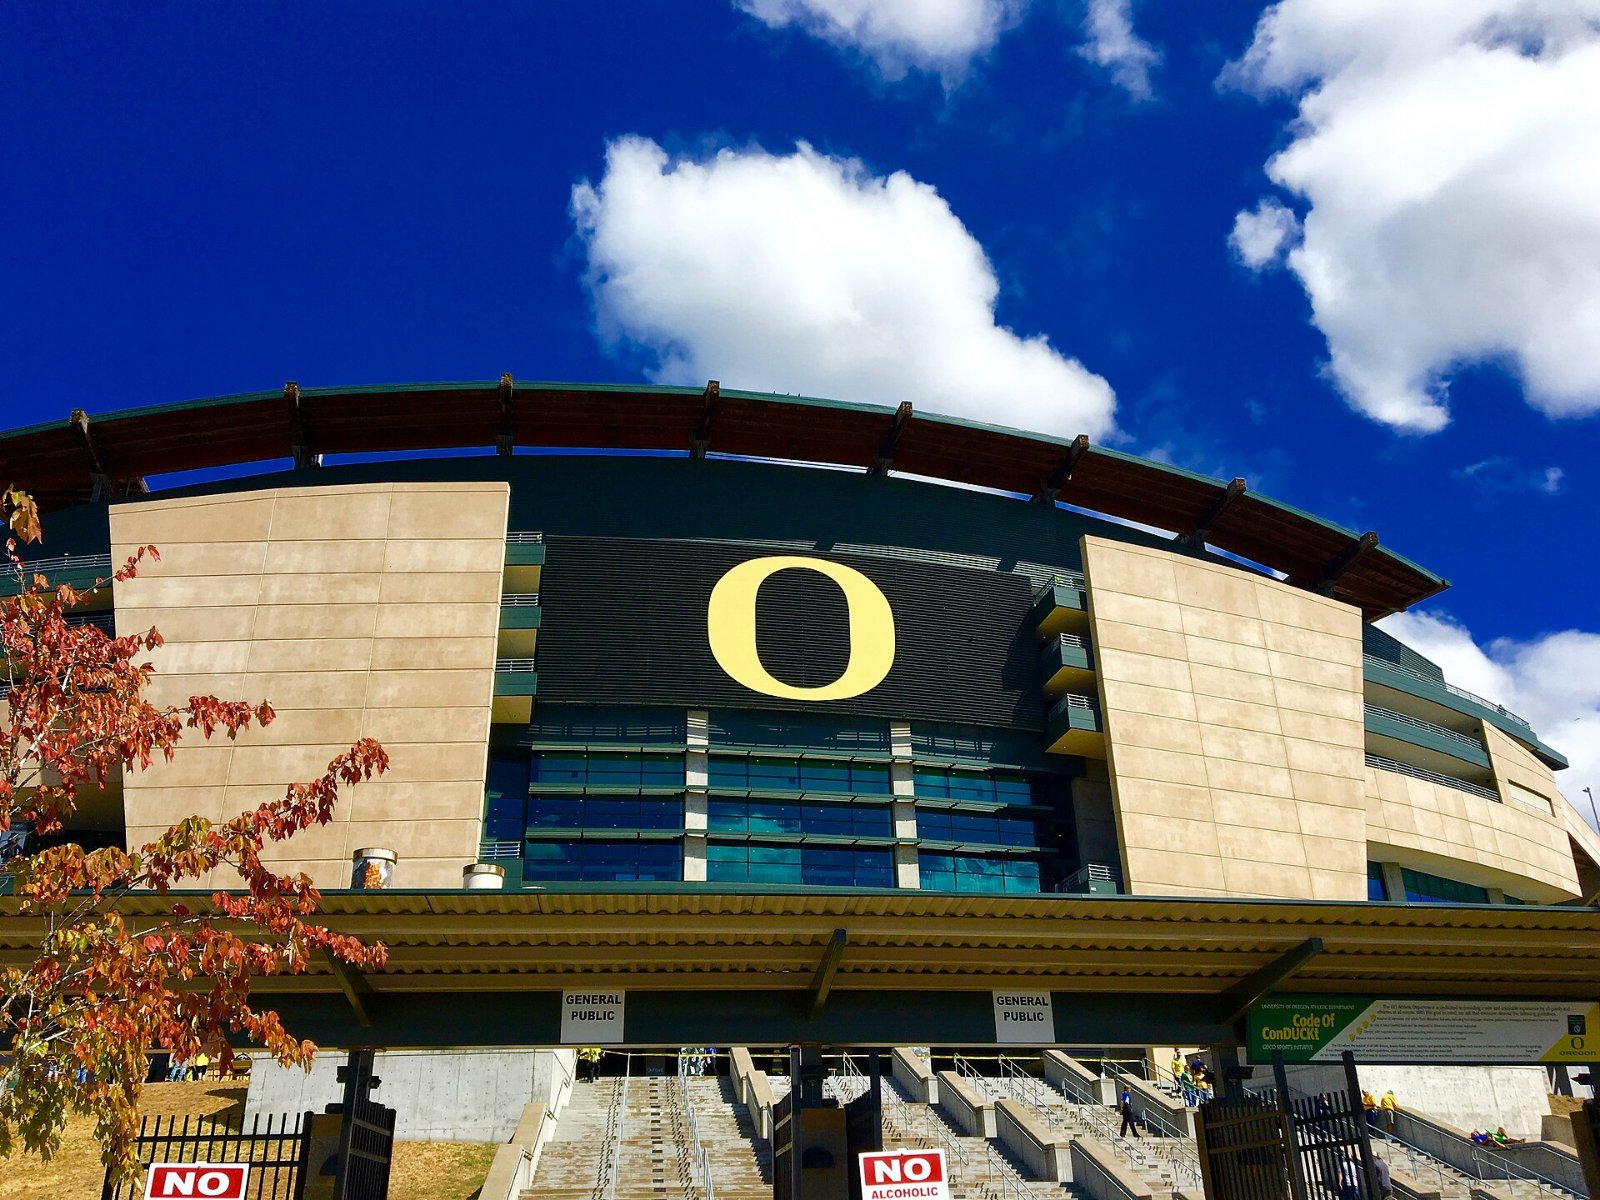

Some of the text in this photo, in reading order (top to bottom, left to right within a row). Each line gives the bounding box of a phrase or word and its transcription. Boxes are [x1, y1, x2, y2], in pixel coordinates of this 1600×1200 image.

[708, 556, 896, 701] O
[566, 994, 622, 1005] GENERAL
[996, 996, 1049, 1006] GENERAL
[571, 1010, 615, 1021] PUBLIC
[1003, 1011, 1044, 1022] PUBLIC
[1292, 1013, 1336, 1028] Code Of
[1261, 1026, 1320, 1041] ConDUCKt
[1571, 1036, 1585, 1050] O
[874, 1158, 931, 1183] NO
[163, 1172, 229, 1196] NO
[872, 1187, 938, 1199] ALCOHOLIC
